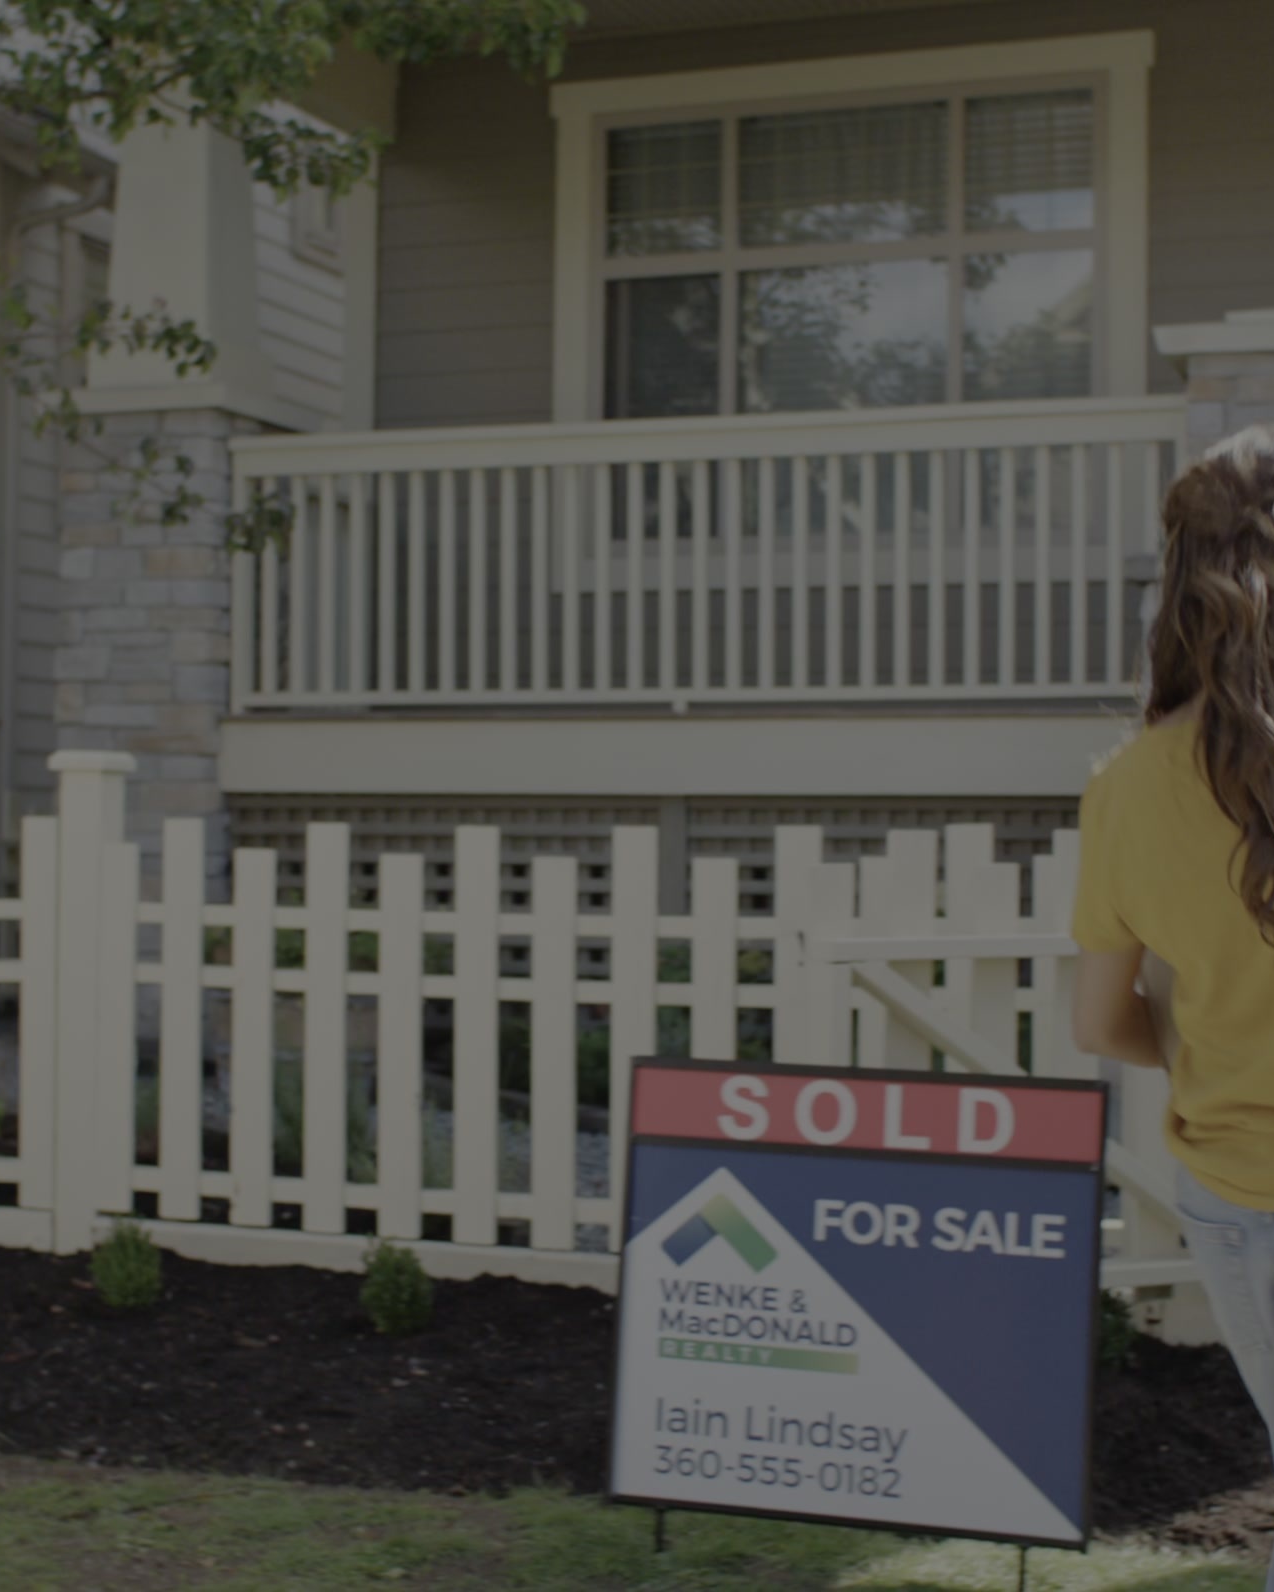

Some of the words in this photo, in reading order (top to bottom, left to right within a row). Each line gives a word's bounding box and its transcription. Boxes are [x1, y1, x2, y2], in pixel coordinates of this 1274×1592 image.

[717, 1074, 1015, 1154] SOLD
[812, 1199, 920, 1248] FOR
[932, 1207, 1066, 1259] SALE
[660, 1278, 778, 1312] WENKE
[790, 1289, 807, 1313] &
[658, 1309, 857, 1347] MacDONALD
[661, 1339, 773, 1365] REALTY
[655, 1398, 728, 1438] Iain
[745, 1406, 908, 1462] Lindsay
[654, 1445, 901, 1498] 360-555-0182
